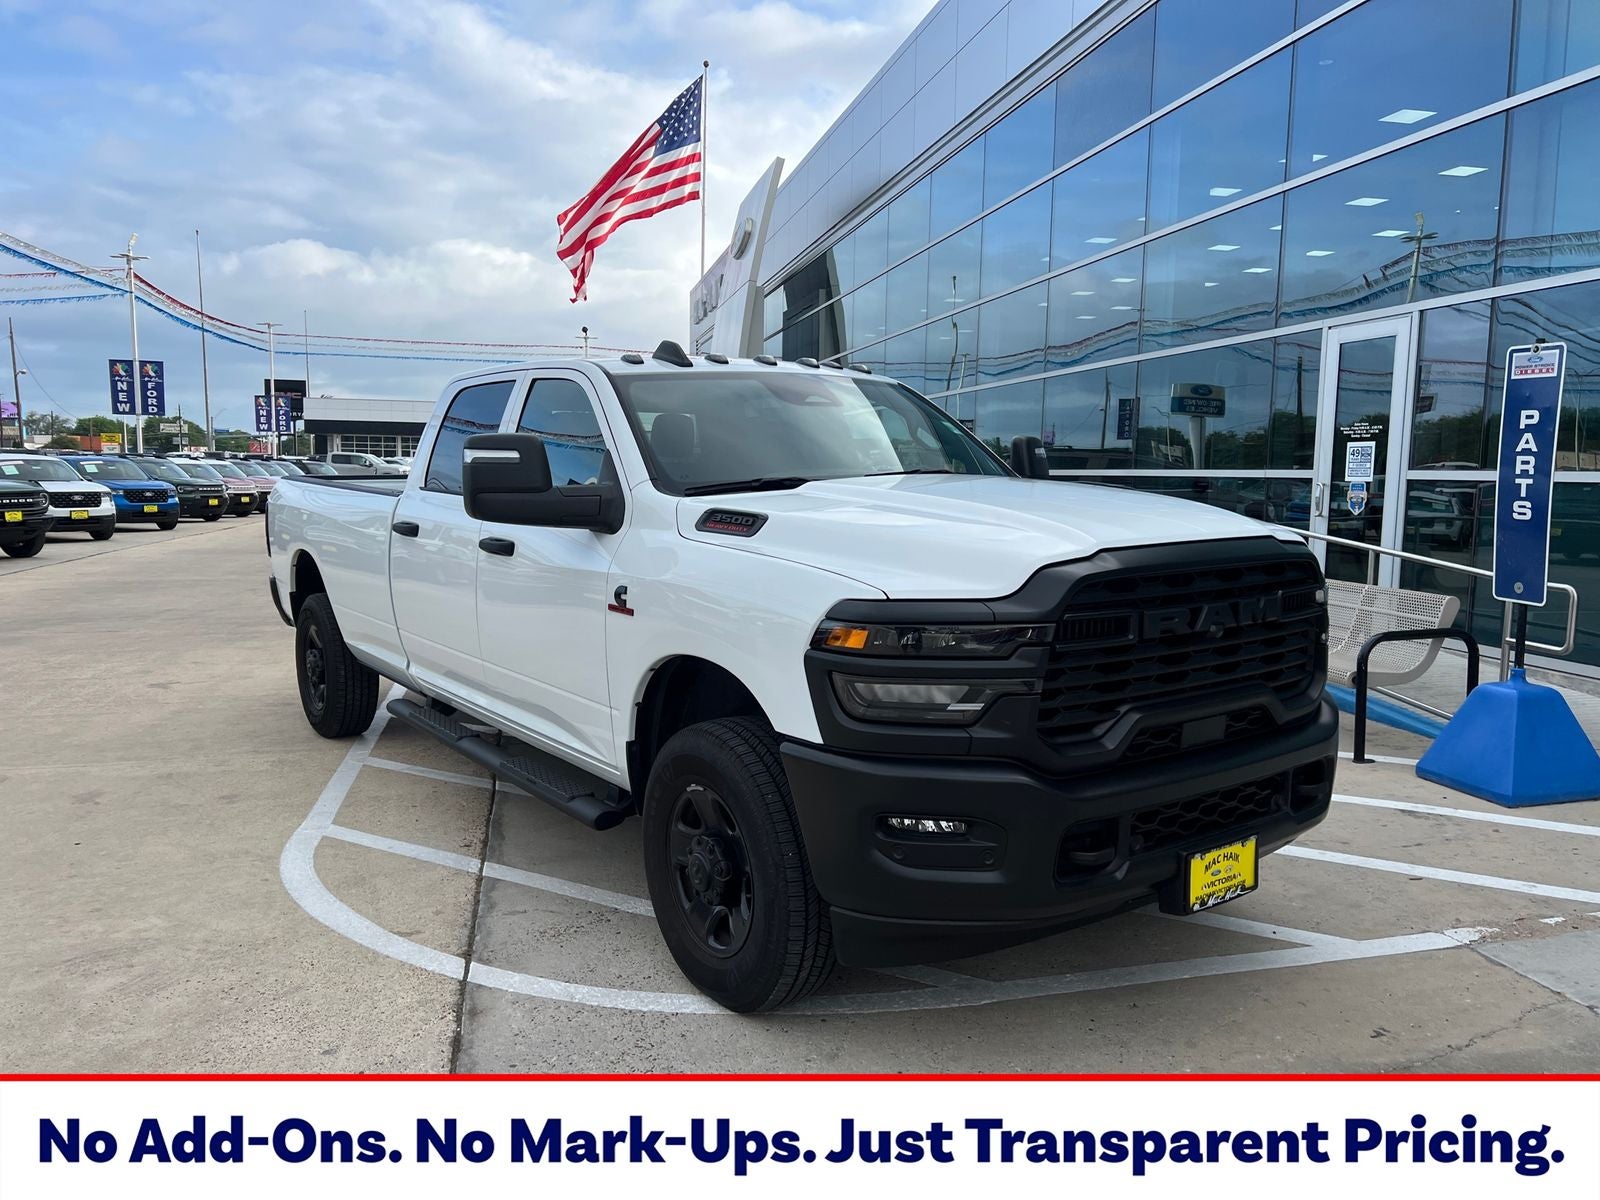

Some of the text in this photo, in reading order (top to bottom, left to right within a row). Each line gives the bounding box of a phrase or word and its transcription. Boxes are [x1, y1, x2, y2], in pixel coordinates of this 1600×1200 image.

[117, 382, 130, 412] NEW
[147, 382, 158, 413] FORD
[259, 410, 268, 430] NEW
[1350, 448, 1360, 458] 49
[1512, 409, 1540, 521] PARTS
[712, 513, 753, 525] 3500
[1143, 593, 1281, 639] RAM
[1203, 851, 1240, 875] MAC HAIK
